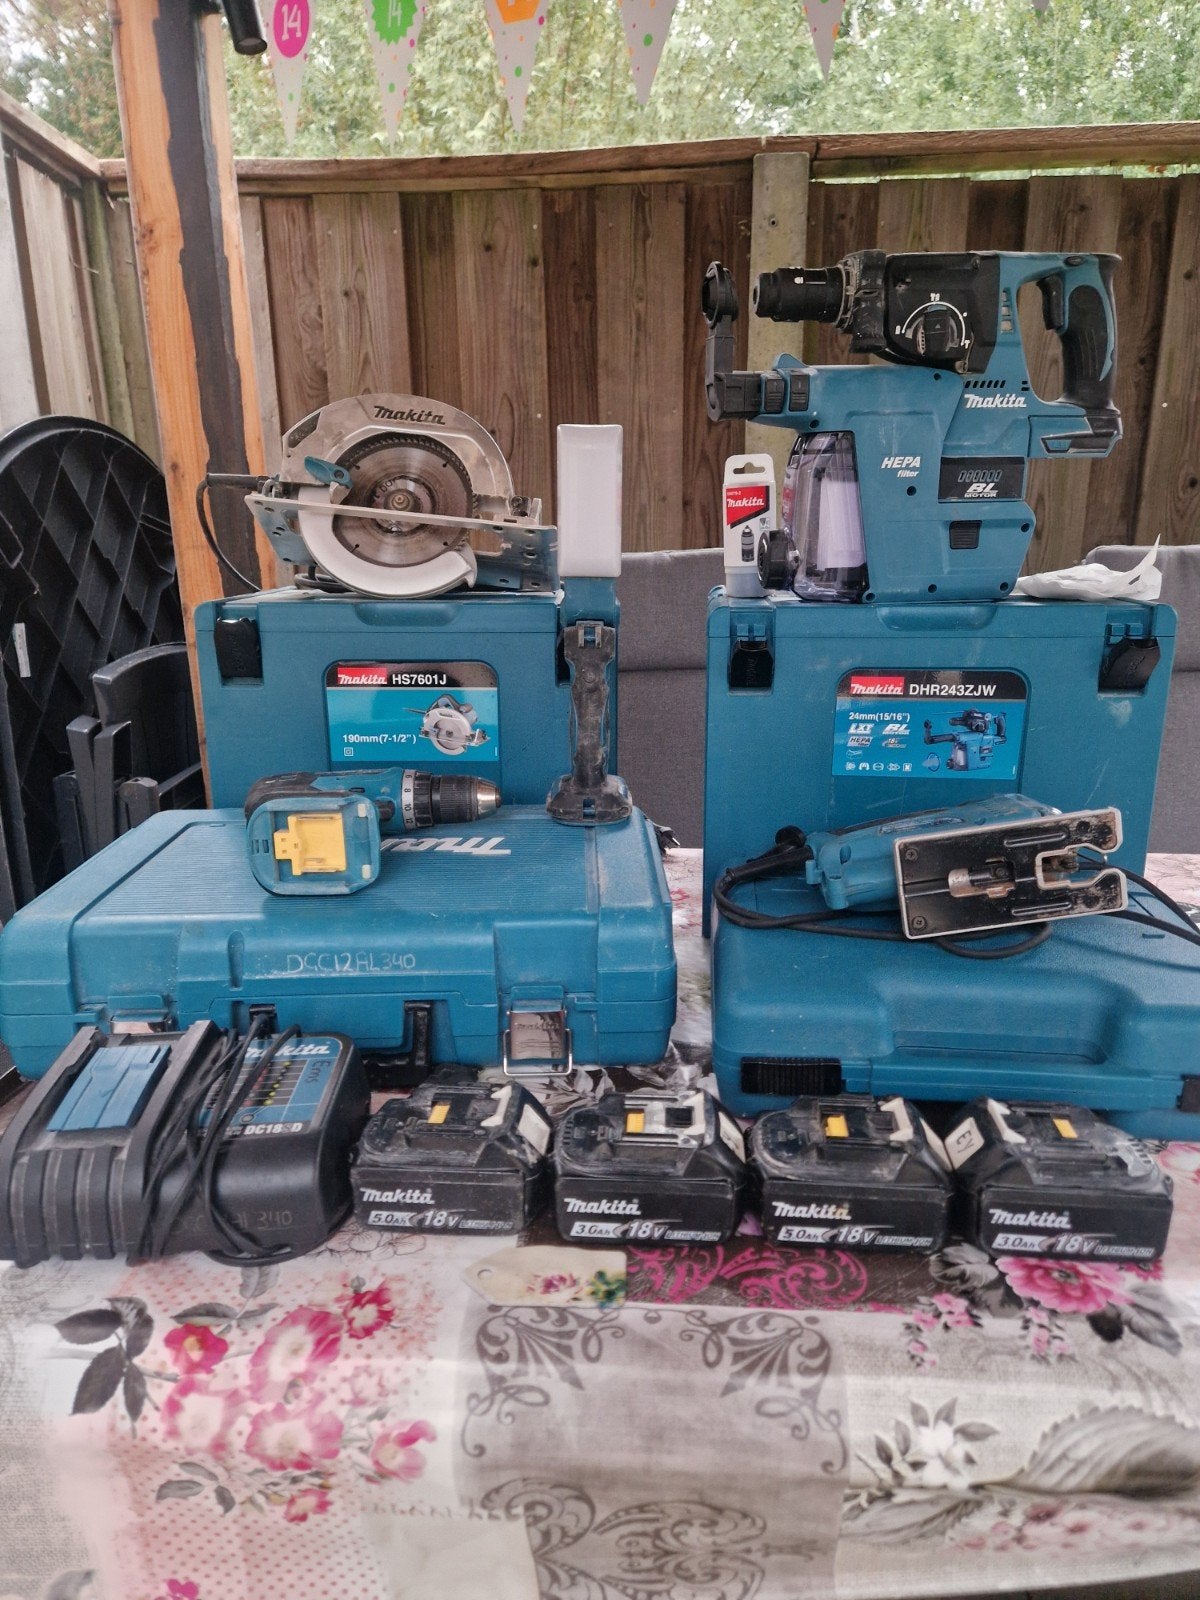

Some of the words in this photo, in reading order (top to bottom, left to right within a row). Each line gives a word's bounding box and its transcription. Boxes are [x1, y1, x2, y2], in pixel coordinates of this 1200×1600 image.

[281, 4, 301, 40] 14
[881, 456, 921, 469] HEPA
[896, 470, 919, 478] filter
[966, 482, 998, 493] BL
[392, 674, 447, 685] HS7601J
[909, 684, 996, 696] DHR243ZJW
[245, 1044, 330, 1058] Mkita
